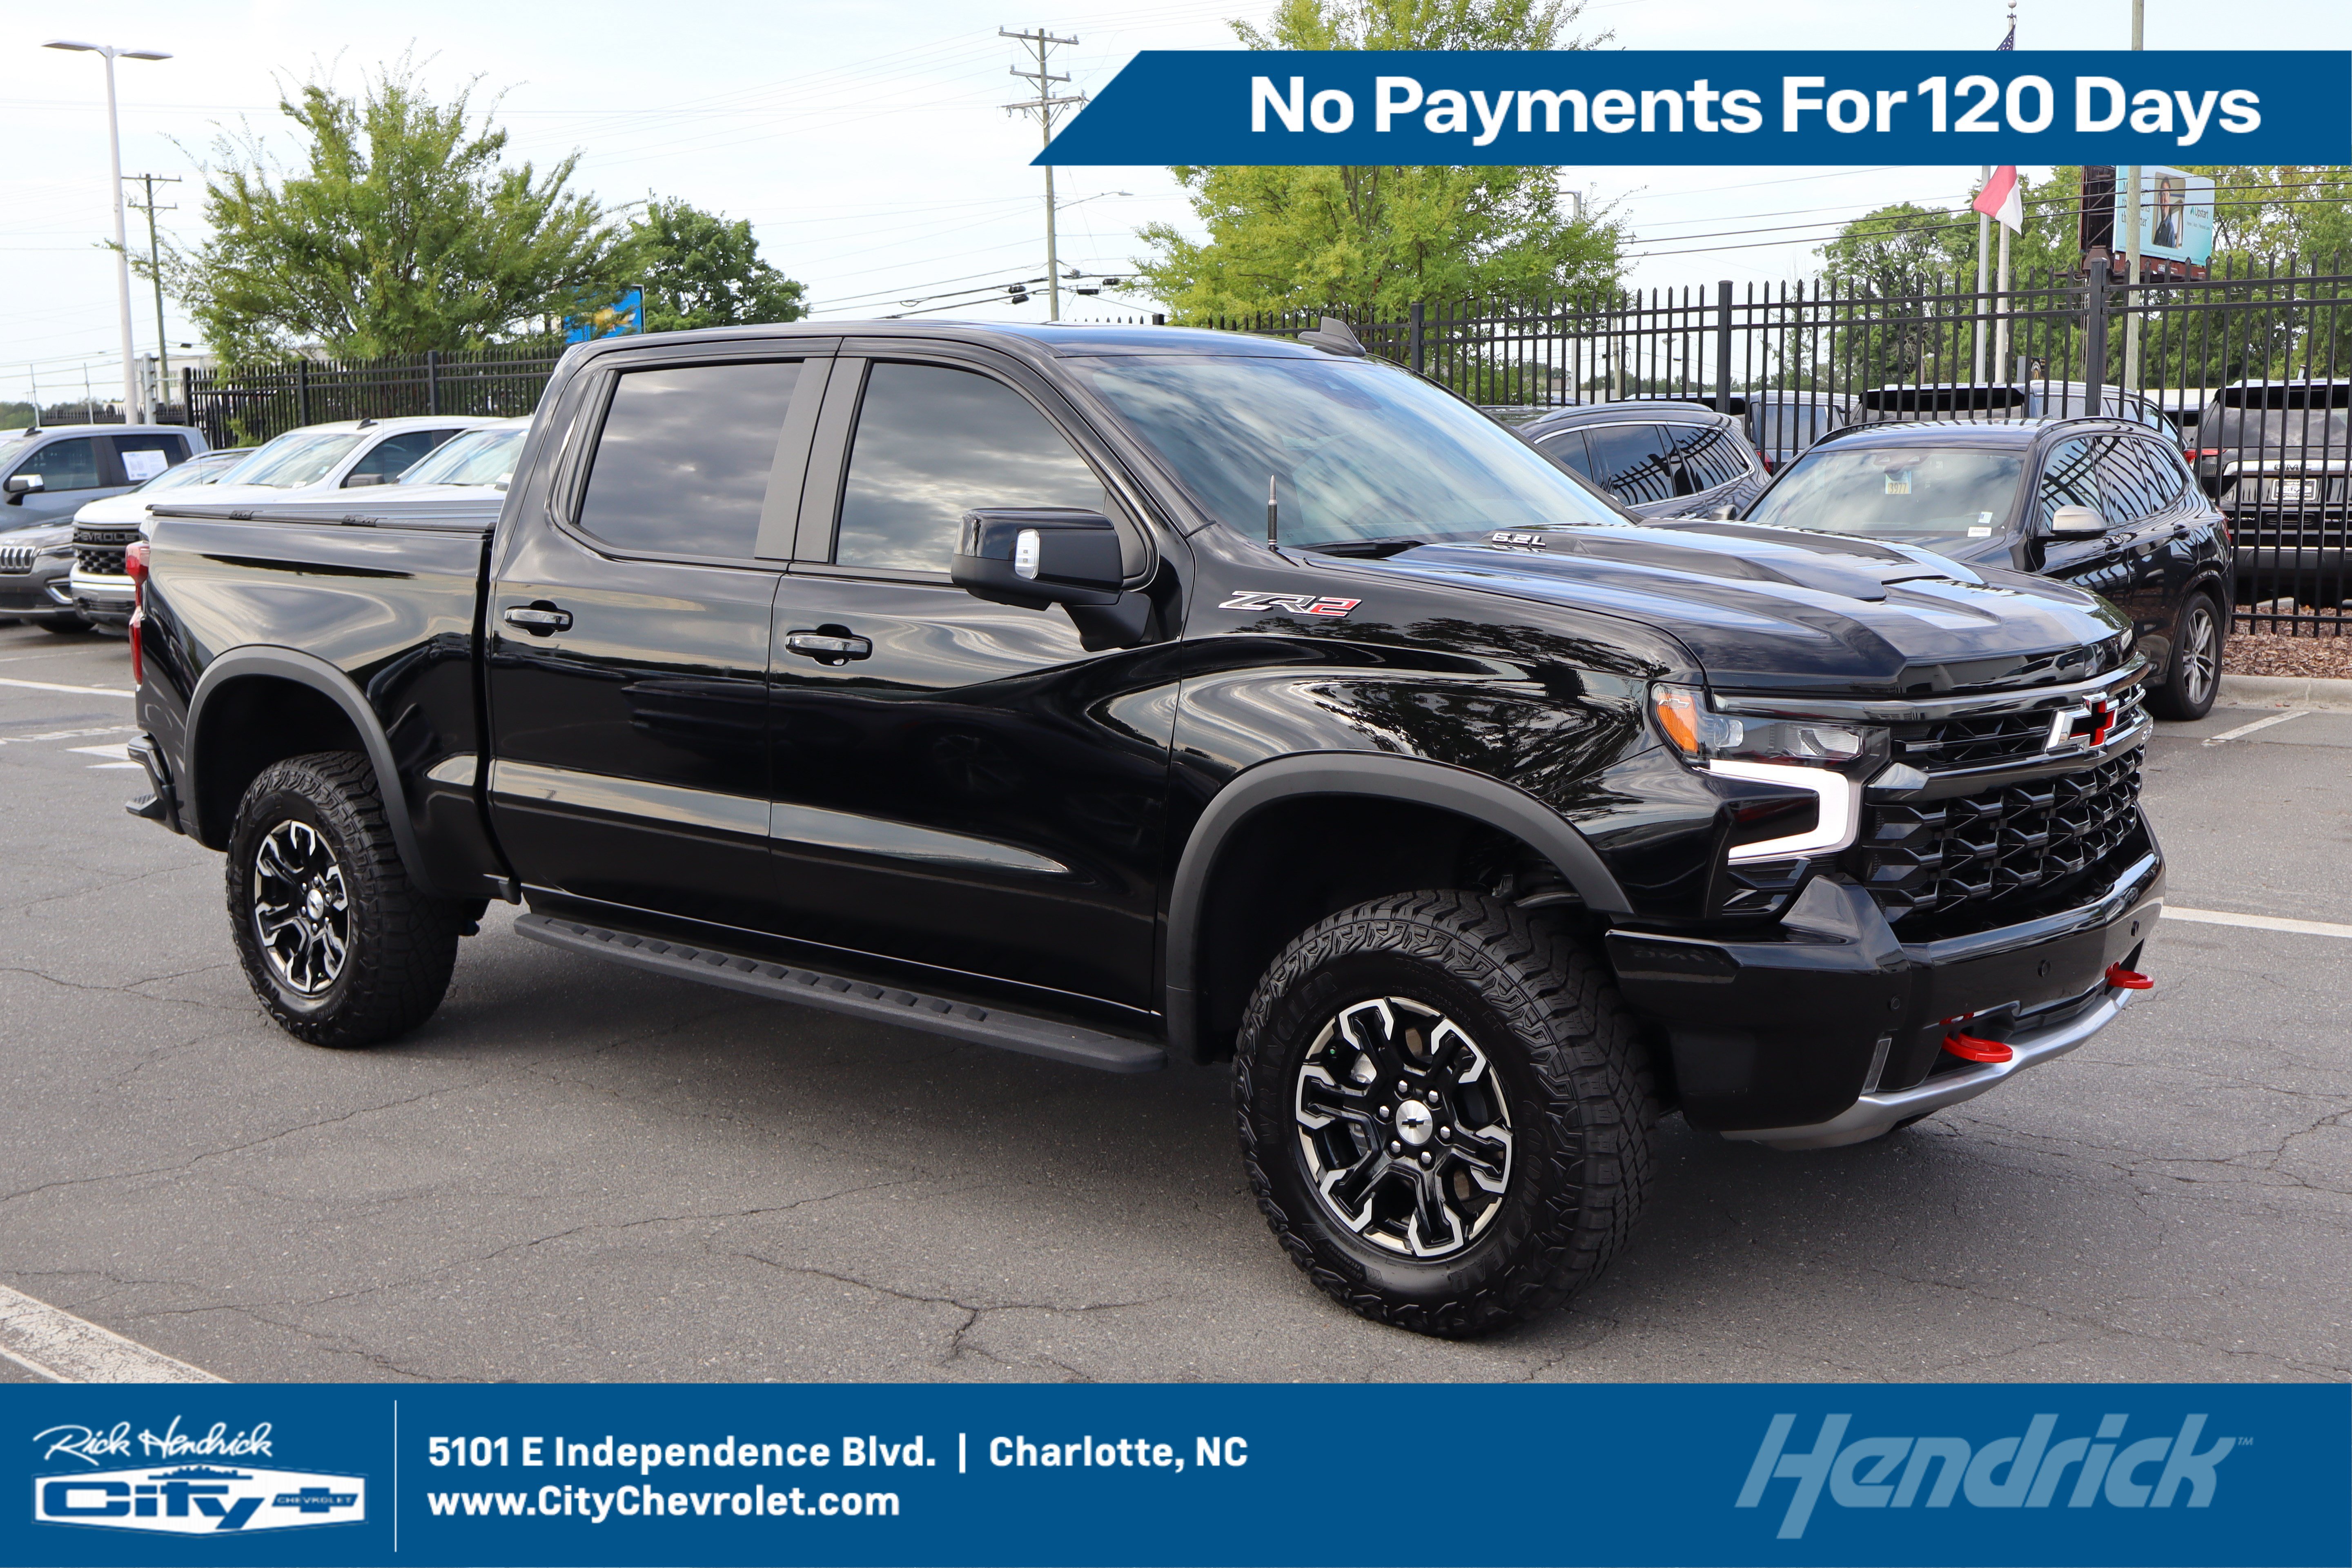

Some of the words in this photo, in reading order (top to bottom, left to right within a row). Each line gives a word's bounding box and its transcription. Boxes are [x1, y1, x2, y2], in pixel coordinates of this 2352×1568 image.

[2195, 206, 2209, 219] Upstart
[1889, 483, 1907, 494] 3977
[1492, 532, 1546, 548] 6.2L
[1218, 590, 1362, 617] ZR2
[1258, 971, 1339, 1145] WRANGLER
